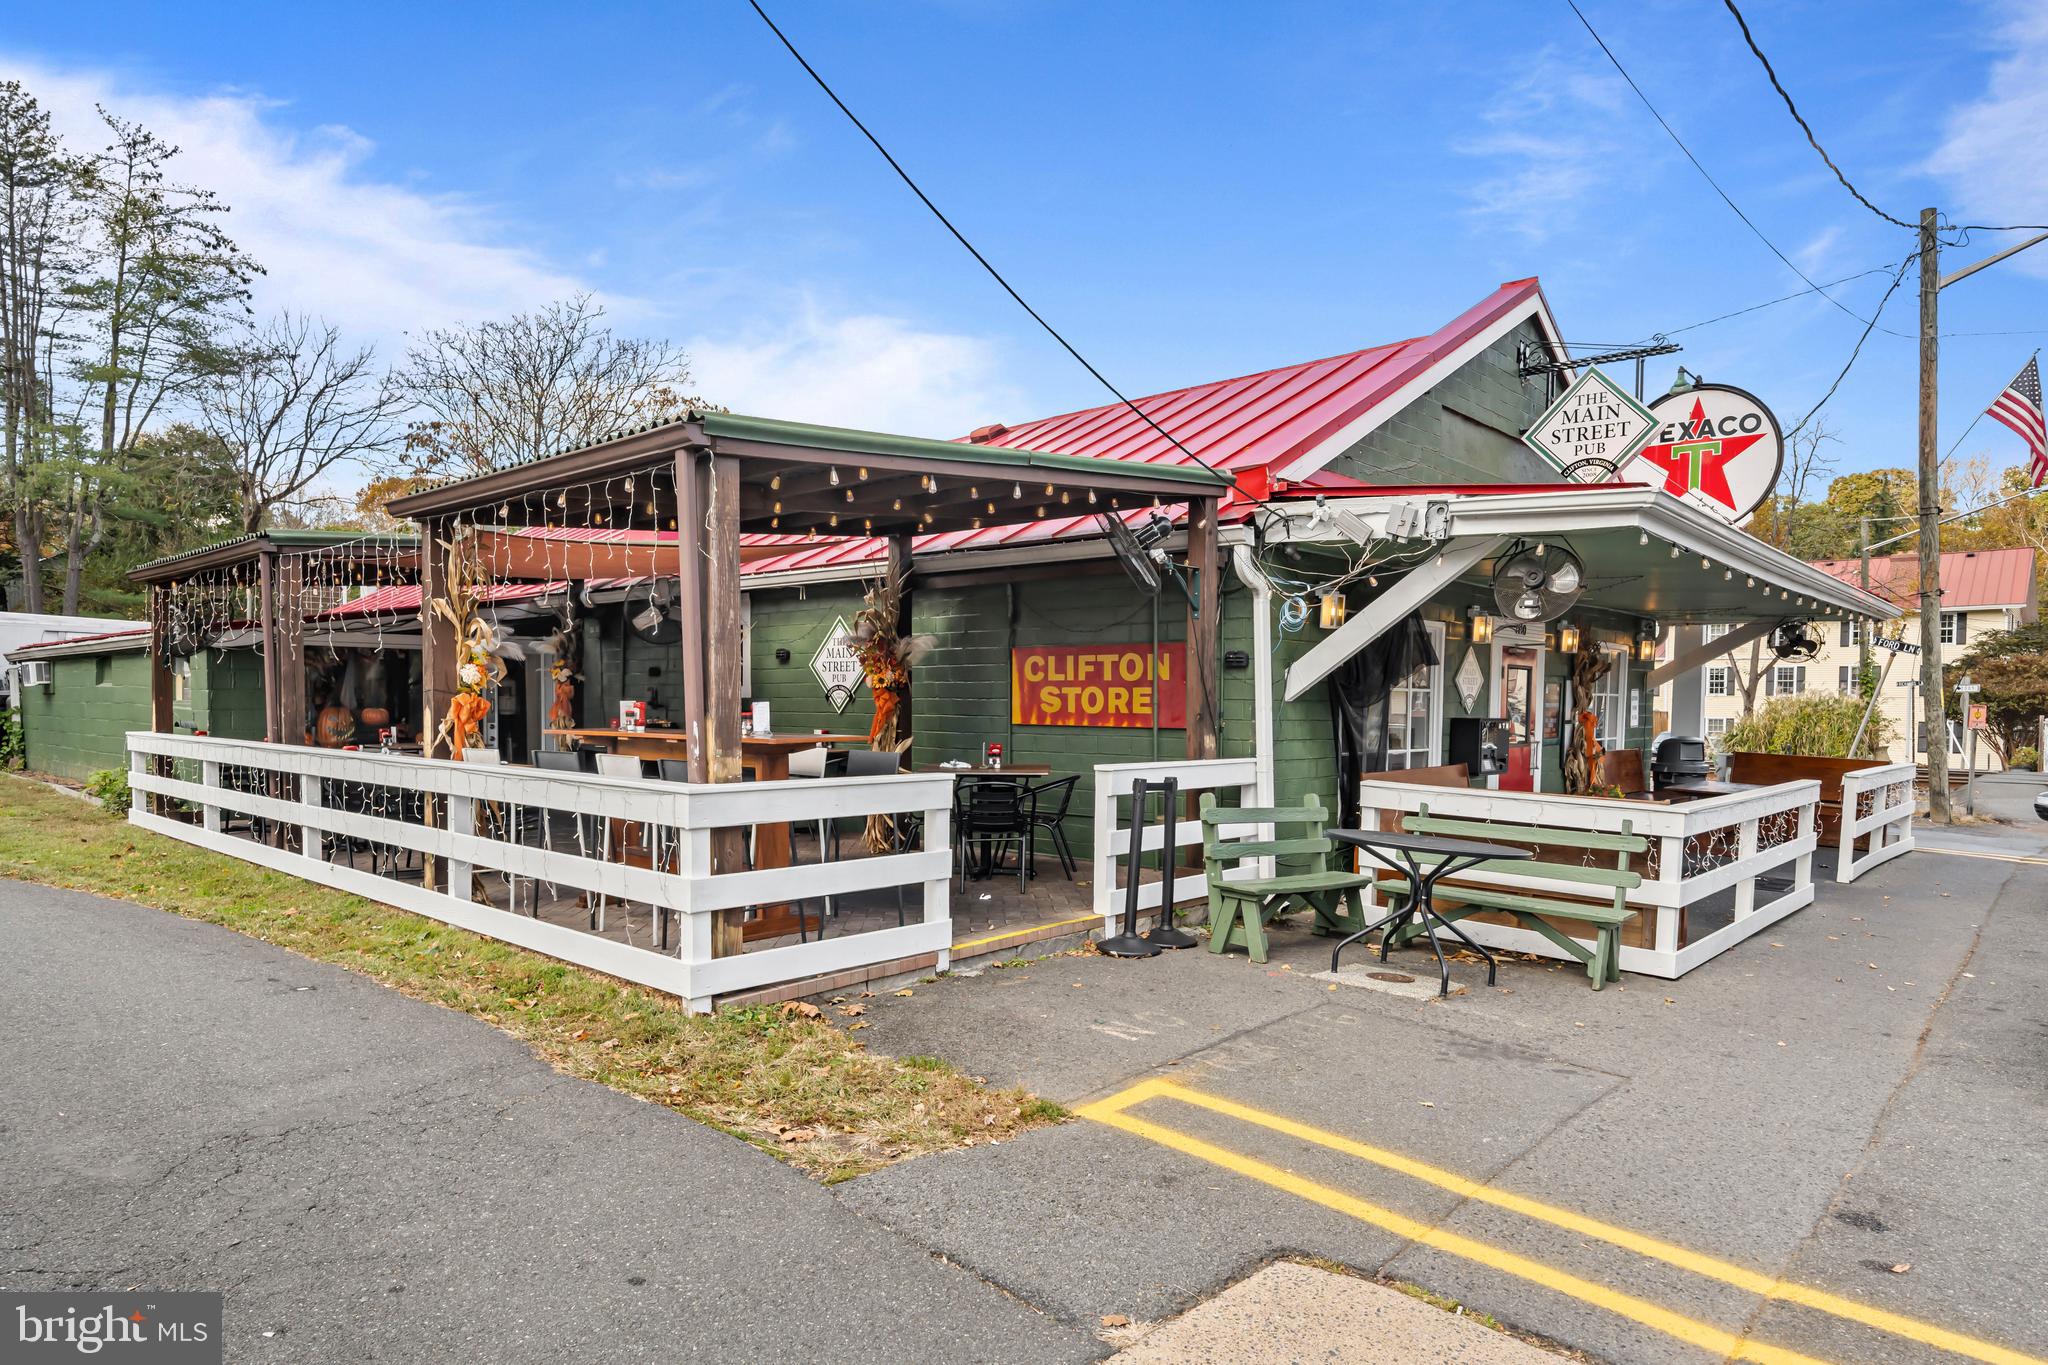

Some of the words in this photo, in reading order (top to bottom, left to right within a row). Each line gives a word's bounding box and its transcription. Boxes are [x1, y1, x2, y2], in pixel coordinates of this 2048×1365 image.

[1575, 392, 1608, 406] THE
[1561, 403, 1621, 425] MAIN
[1551, 421, 1631, 445] STREET
[1660, 413, 1762, 443] EXACO
[1574, 442, 1606, 456] PUB
[826, 648, 852, 658] MAIN
[1878, 638, 1900, 650] FORD
[1903, 644, 1916, 653] LN
[822, 661, 857, 672] STREET
[1024, 652, 1170, 682] CLIFTON
[832, 674, 847, 682] PUB
[1040, 686, 1153, 714] STORE
